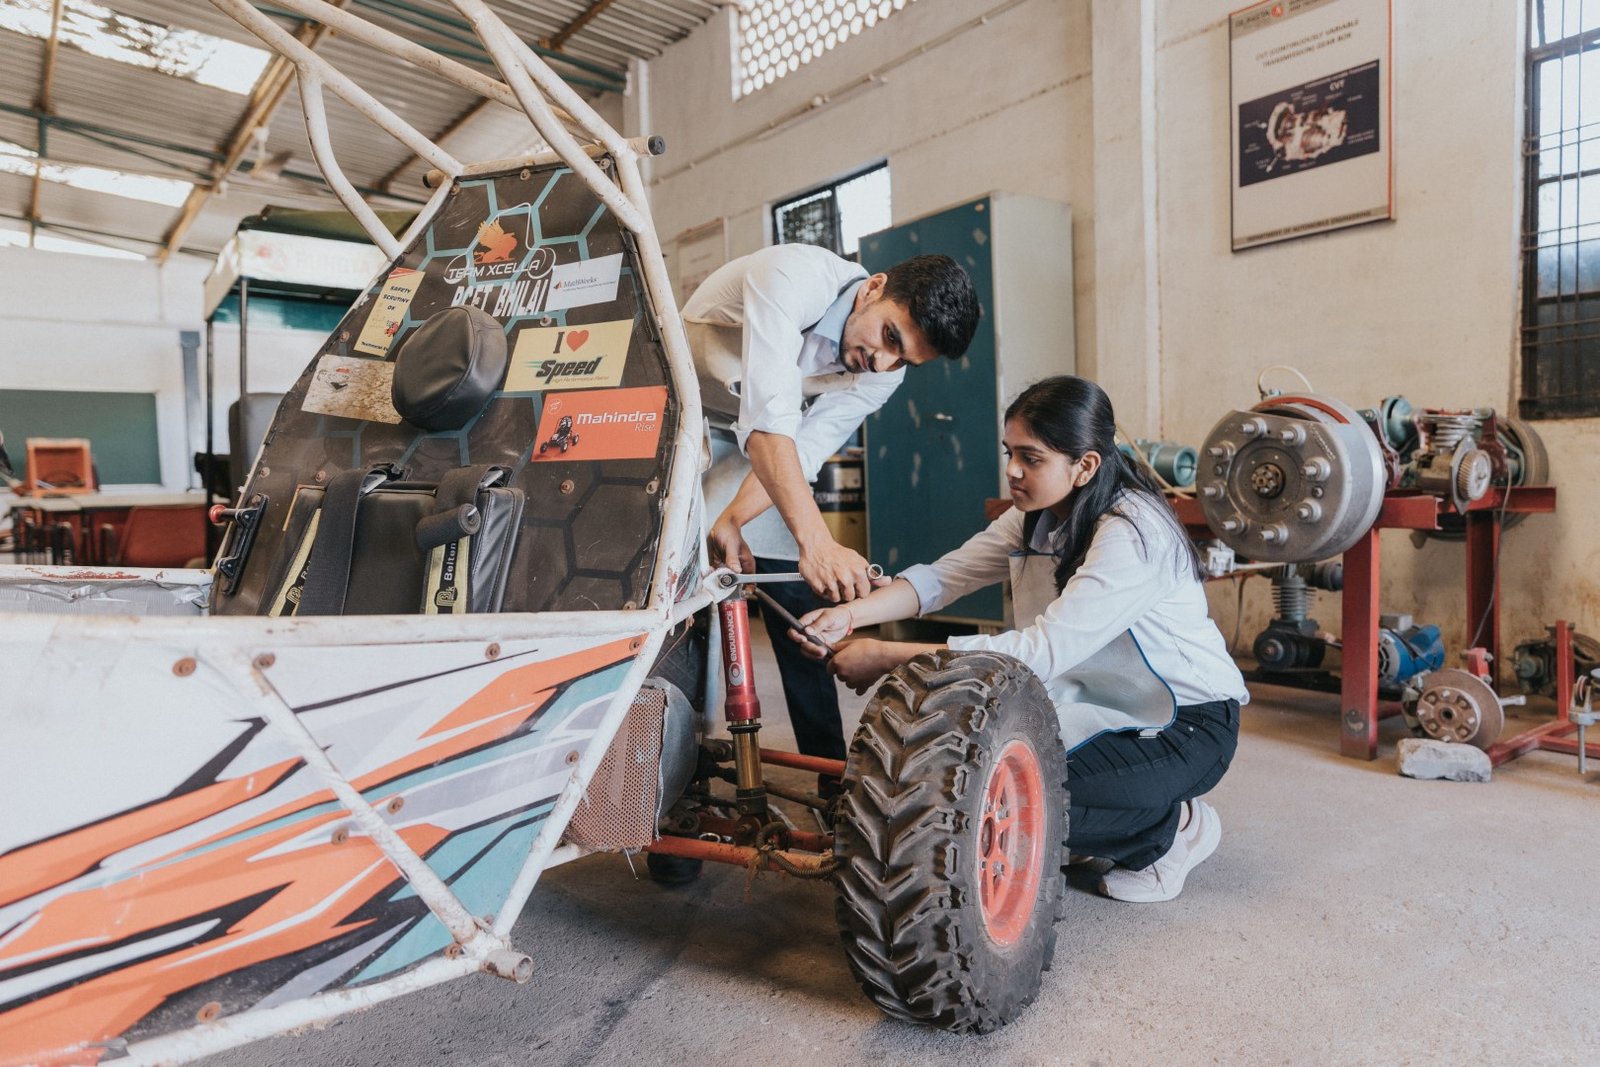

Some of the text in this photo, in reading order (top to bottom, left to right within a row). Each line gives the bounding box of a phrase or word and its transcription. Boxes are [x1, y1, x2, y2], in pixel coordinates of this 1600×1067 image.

[449, 265, 485, 280] TEAM
[383, 294, 410, 303] SCRUTINY
[390, 286, 412, 294] SAFETY
[492, 279, 549, 317] BHILAI
[553, 331, 565, 354] I
[535, 354, 603, 385] Speed
[444, 542, 456, 581] Belton
[726, 610, 737, 661] ENDURANCE
